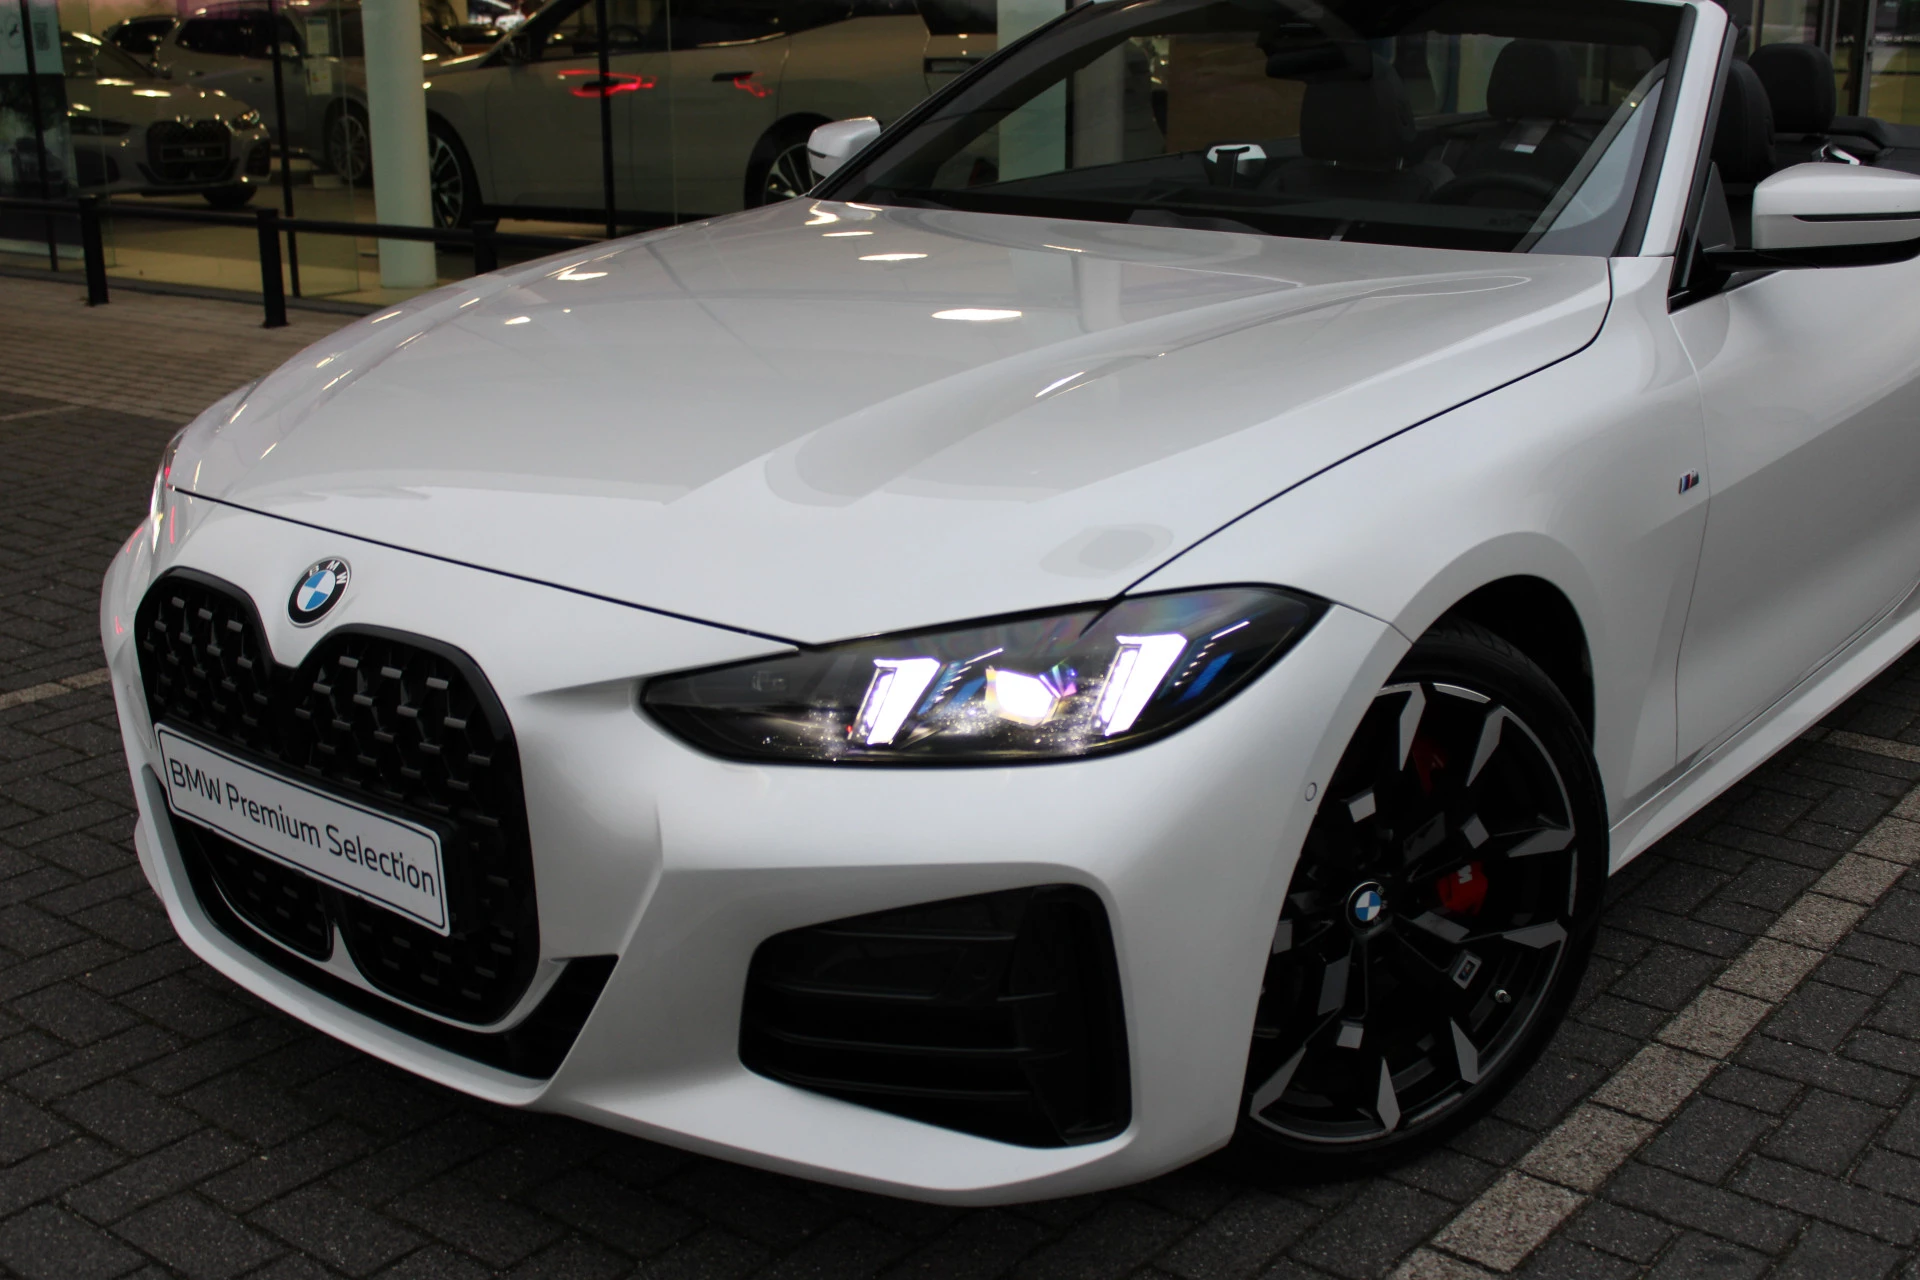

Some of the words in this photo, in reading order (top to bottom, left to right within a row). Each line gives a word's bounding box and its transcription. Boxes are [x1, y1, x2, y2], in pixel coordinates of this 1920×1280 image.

[308, 559, 347, 585] BMW
[168, 757, 221, 804] BMW
[225, 782, 322, 848] Premium
[325, 824, 437, 898] Selection
